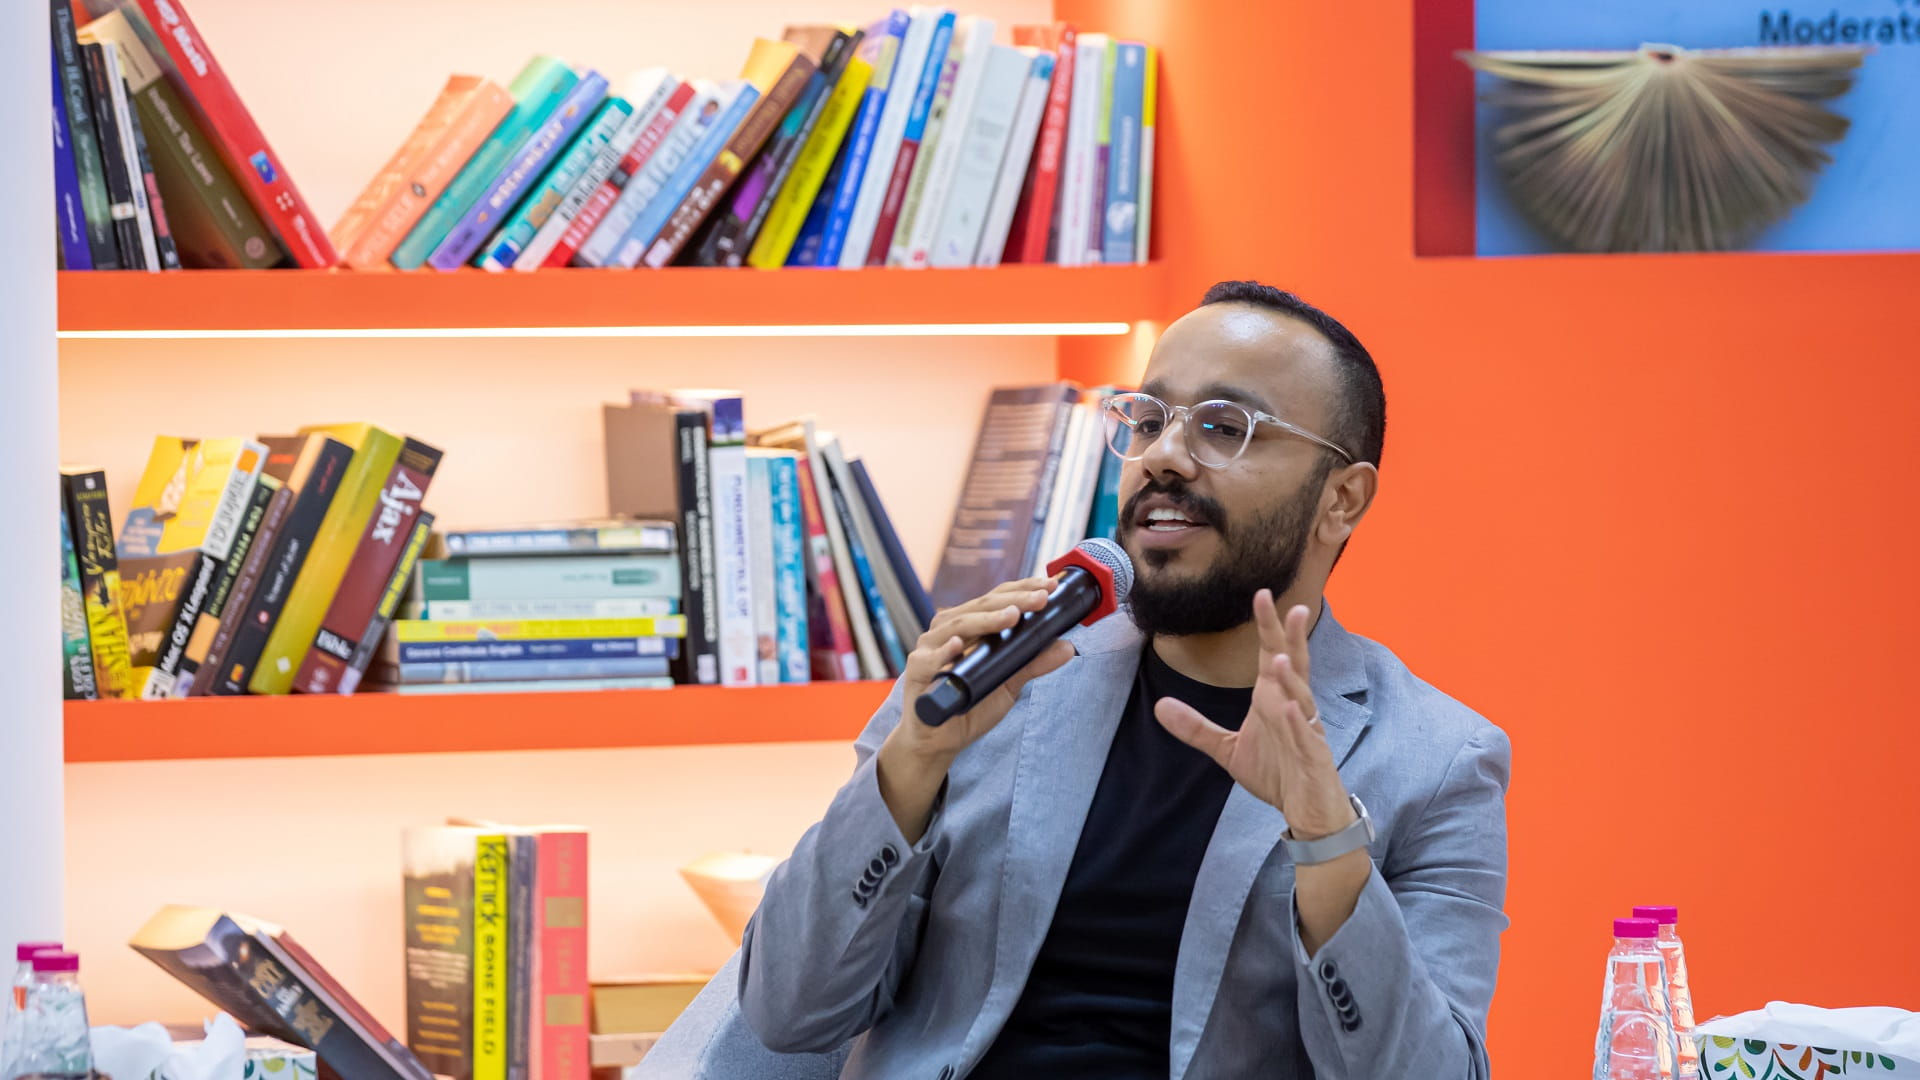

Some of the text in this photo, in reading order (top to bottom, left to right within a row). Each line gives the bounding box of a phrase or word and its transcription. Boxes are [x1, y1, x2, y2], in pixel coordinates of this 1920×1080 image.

[1759, 9, 1920, 44] Moderat
[372, 470, 423, 546] Ajax
[160, 556, 216, 672] Mac OS X Leopard
